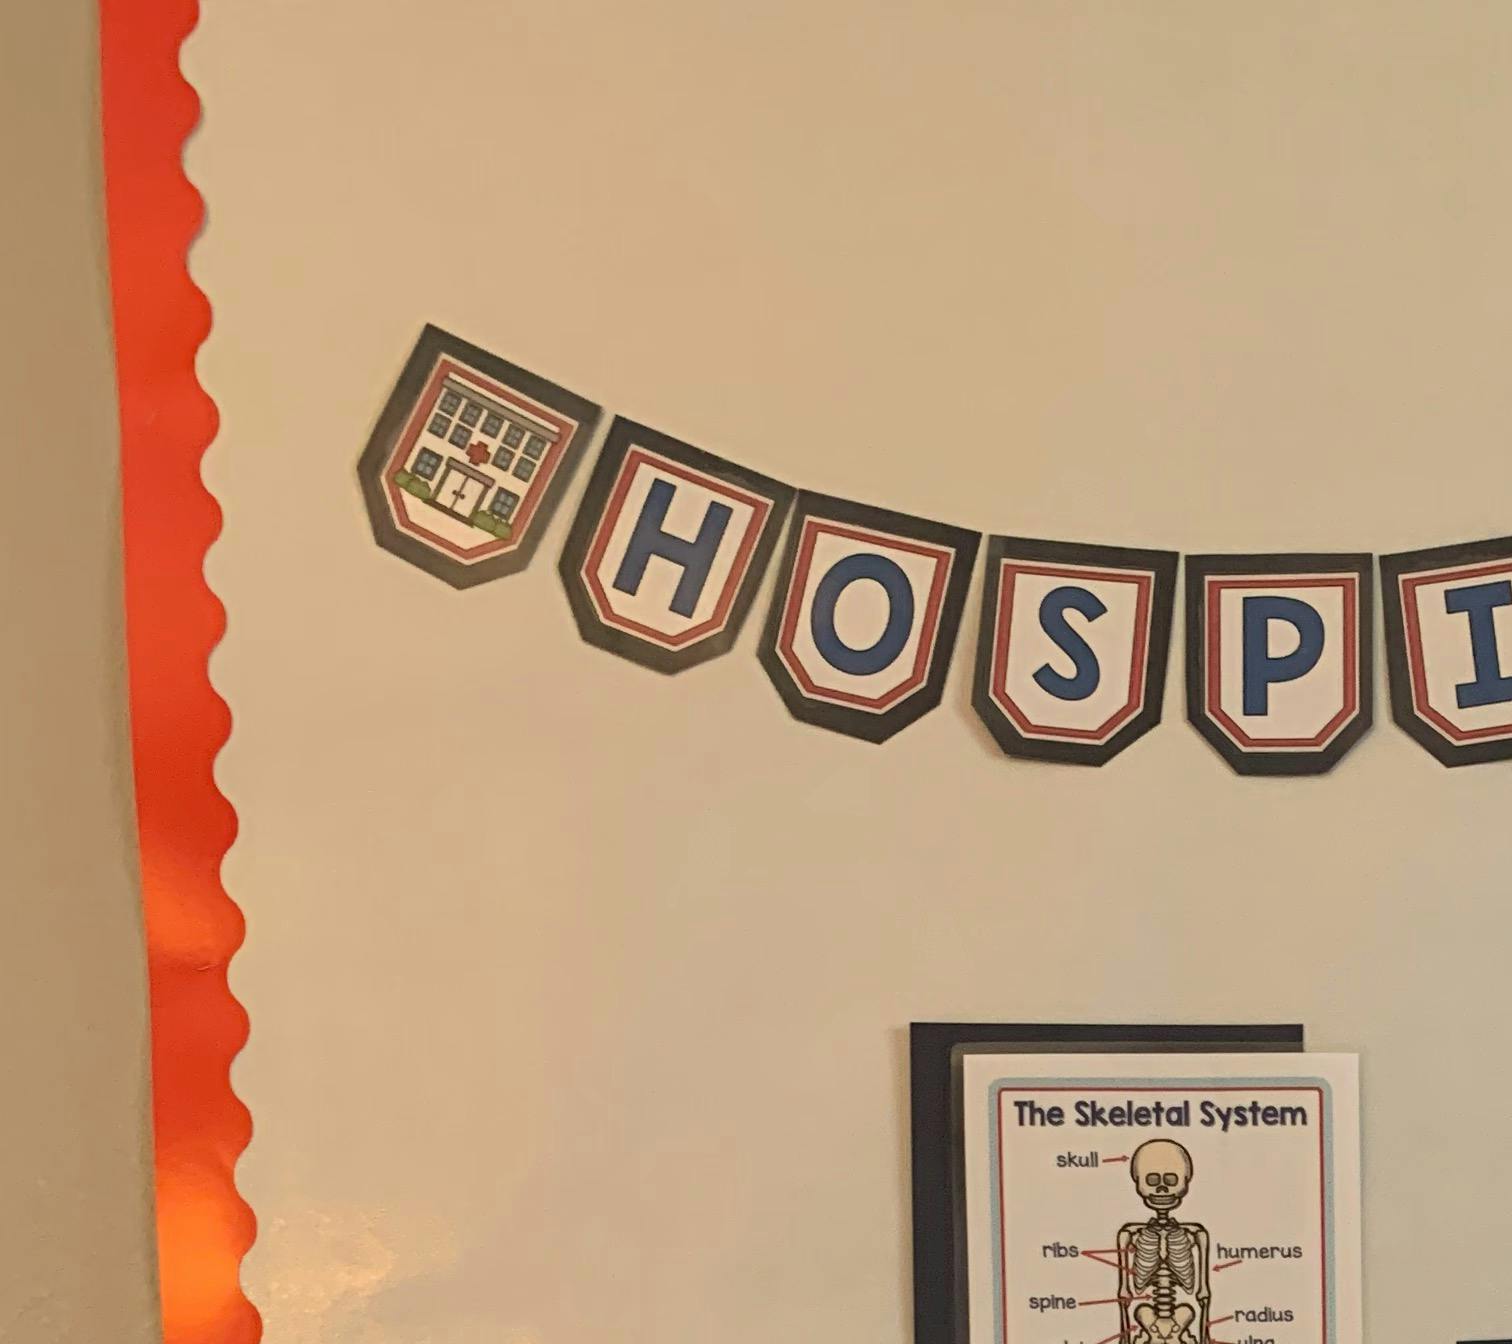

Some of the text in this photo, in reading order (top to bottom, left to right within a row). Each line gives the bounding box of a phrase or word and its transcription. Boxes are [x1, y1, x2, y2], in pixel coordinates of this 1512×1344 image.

[1014, 1100, 1307, 1132] The Skeletal System
[1056, 1151, 1099, 1168] skull
[1042, 1242, 1079, 1259] ribs
[1217, 1243, 1303, 1260] humerus
[1029, 1294, 1076, 1312] spine
[1235, 1307, 1294, 1324] radius
